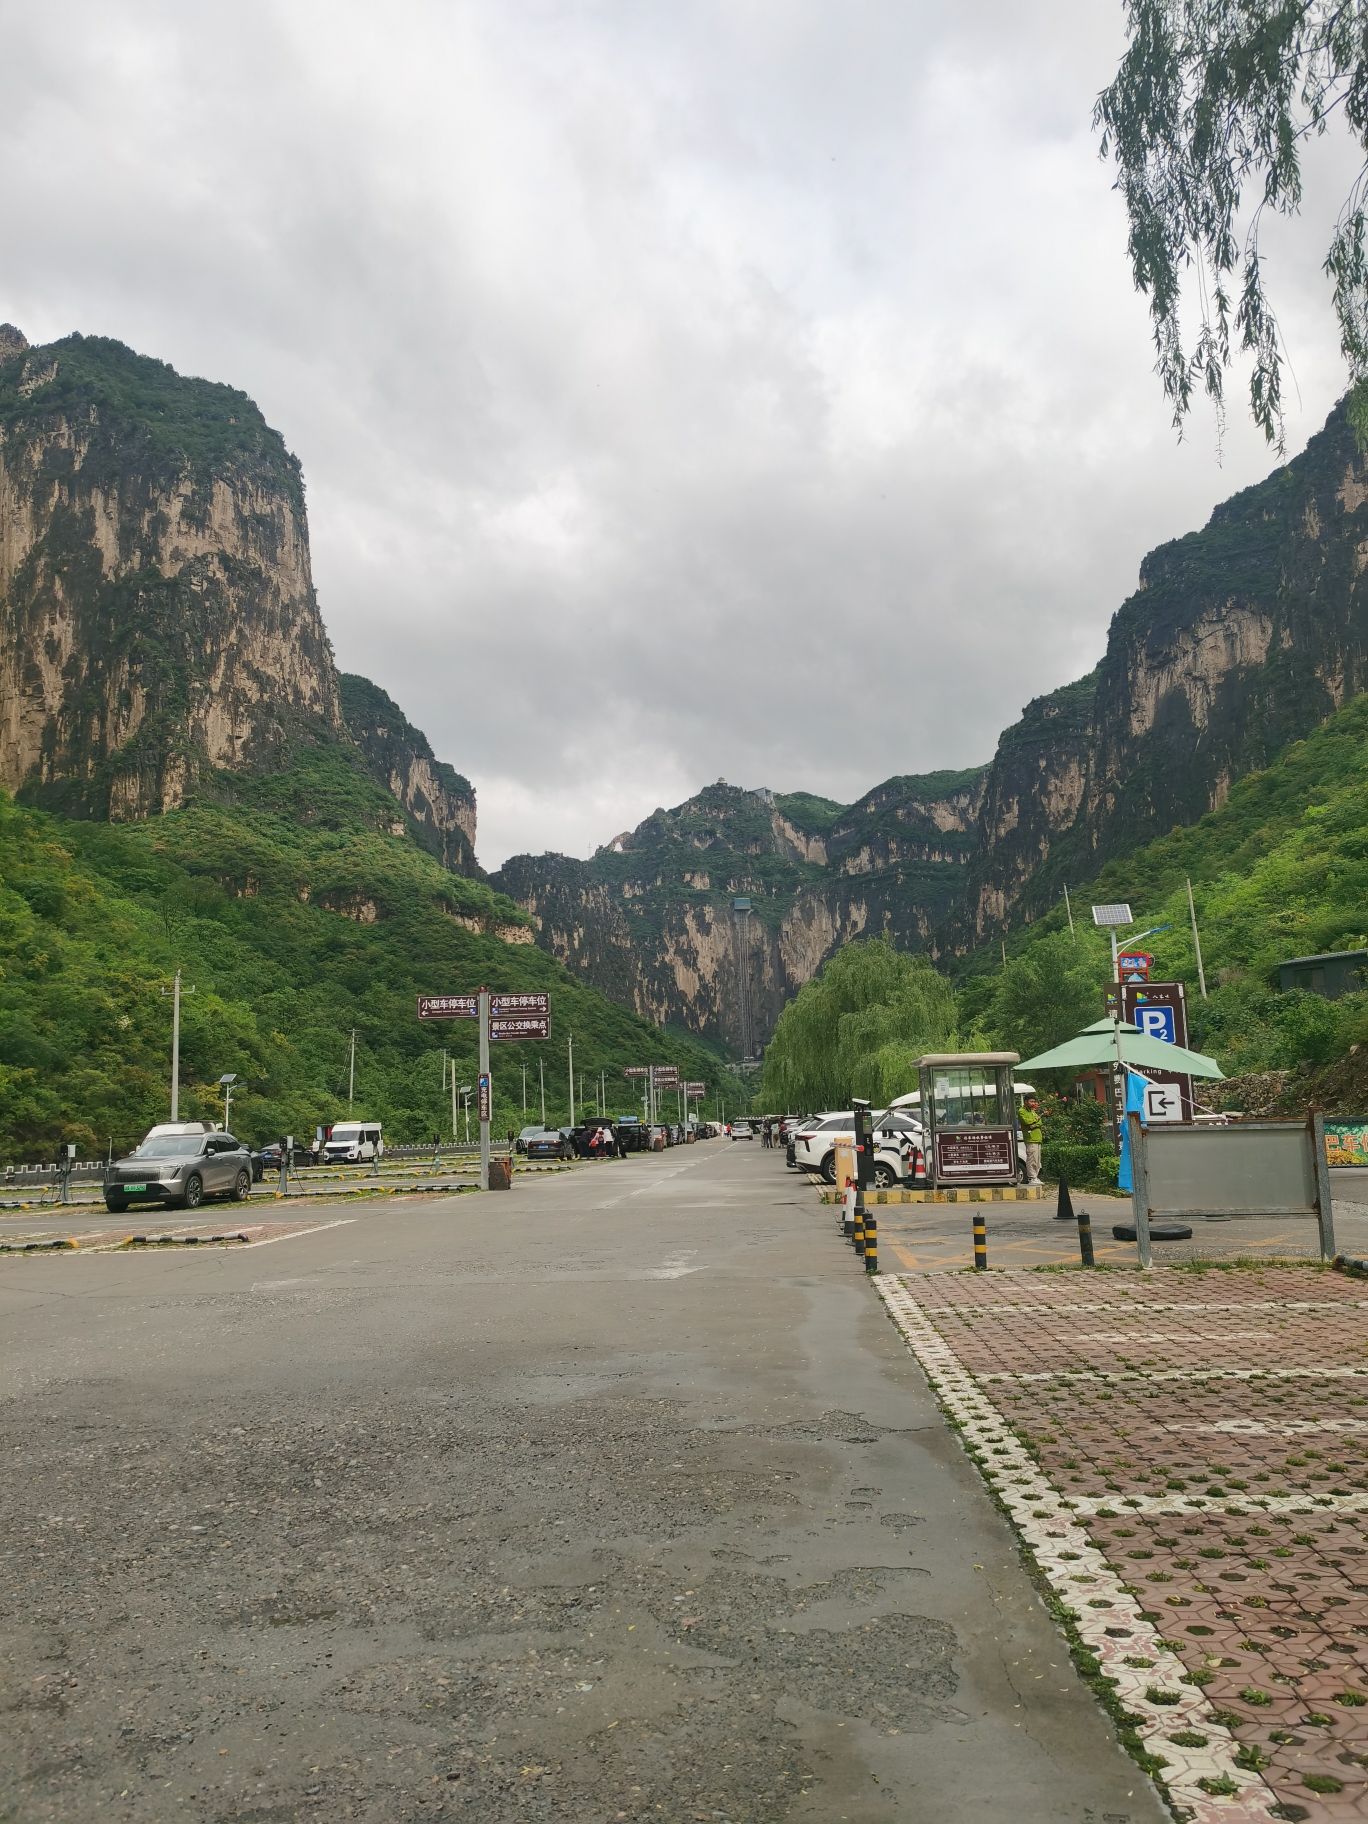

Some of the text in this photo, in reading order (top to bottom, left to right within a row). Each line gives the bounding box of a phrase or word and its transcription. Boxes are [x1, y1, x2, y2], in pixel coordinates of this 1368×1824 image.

[421, 998, 476, 1009] 小型车停车位
[491, 995, 546, 1007] 小型车停车位
[491, 1020, 546, 1030] 景区公交换乘点
